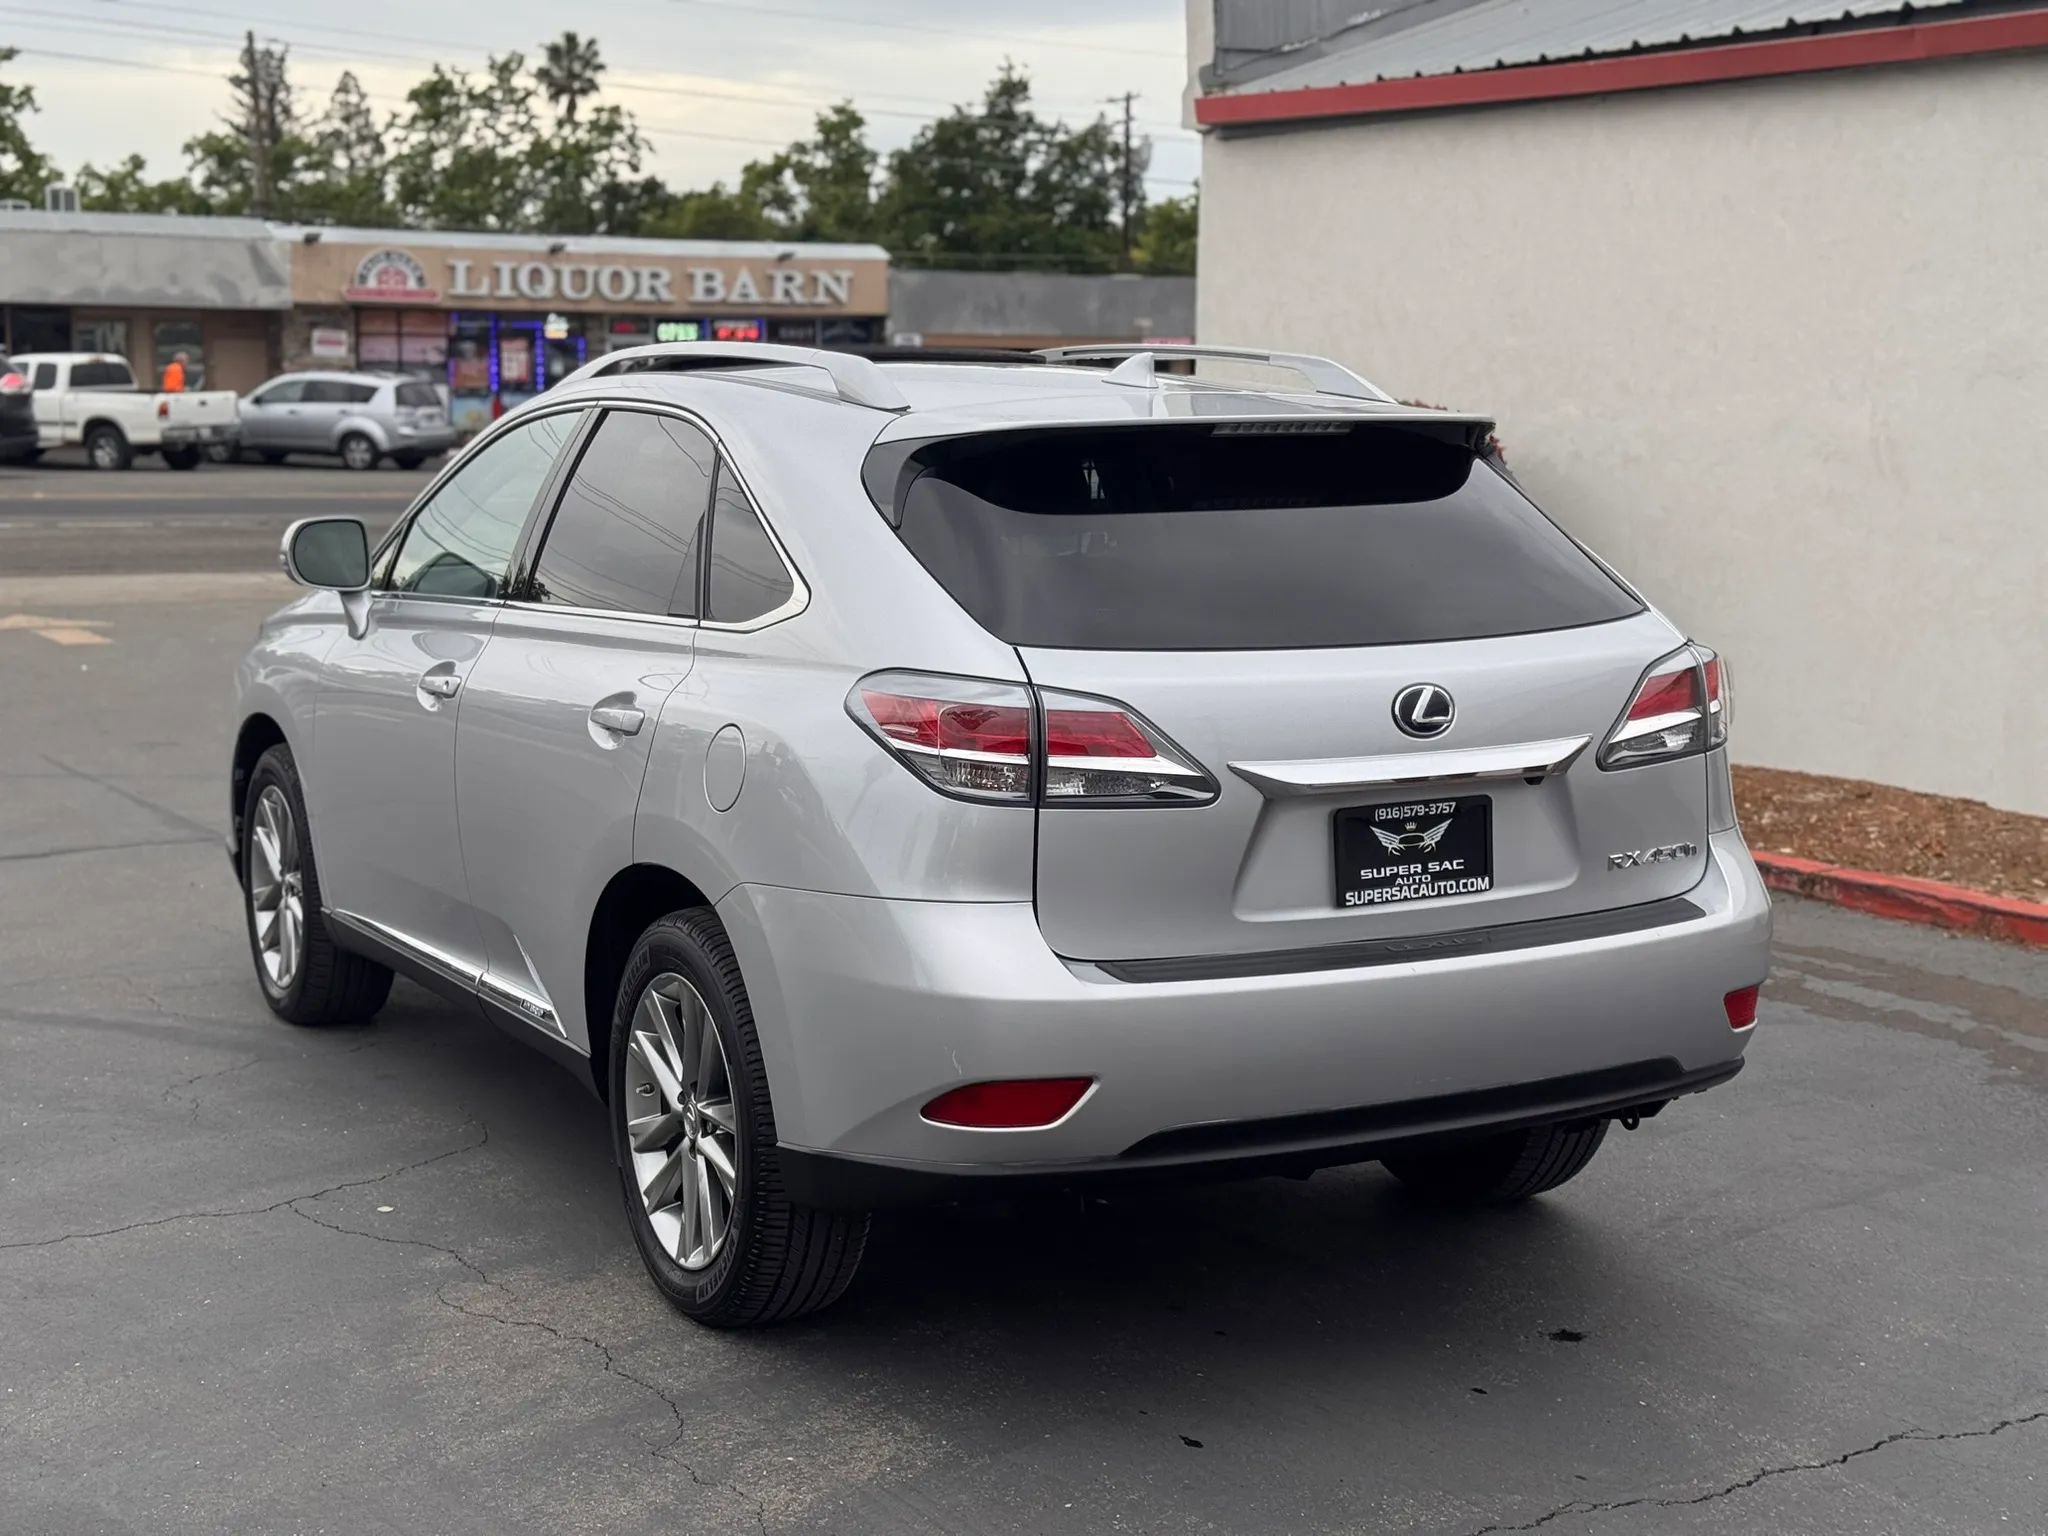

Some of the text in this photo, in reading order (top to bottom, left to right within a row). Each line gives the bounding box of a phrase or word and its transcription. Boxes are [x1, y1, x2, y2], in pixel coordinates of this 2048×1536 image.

[448, 260, 674, 303] LIQUOR
[688, 266, 854, 305] BARN
[1375, 802, 1457, 822] (916)579-3757
[1361, 859, 1465, 879] SUPER SAC
[1607, 850, 1641, 871] RX
[1395, 874, 1431, 886] AUTO
[1345, 876, 1490, 906] SUPERSACAUTO.COM
